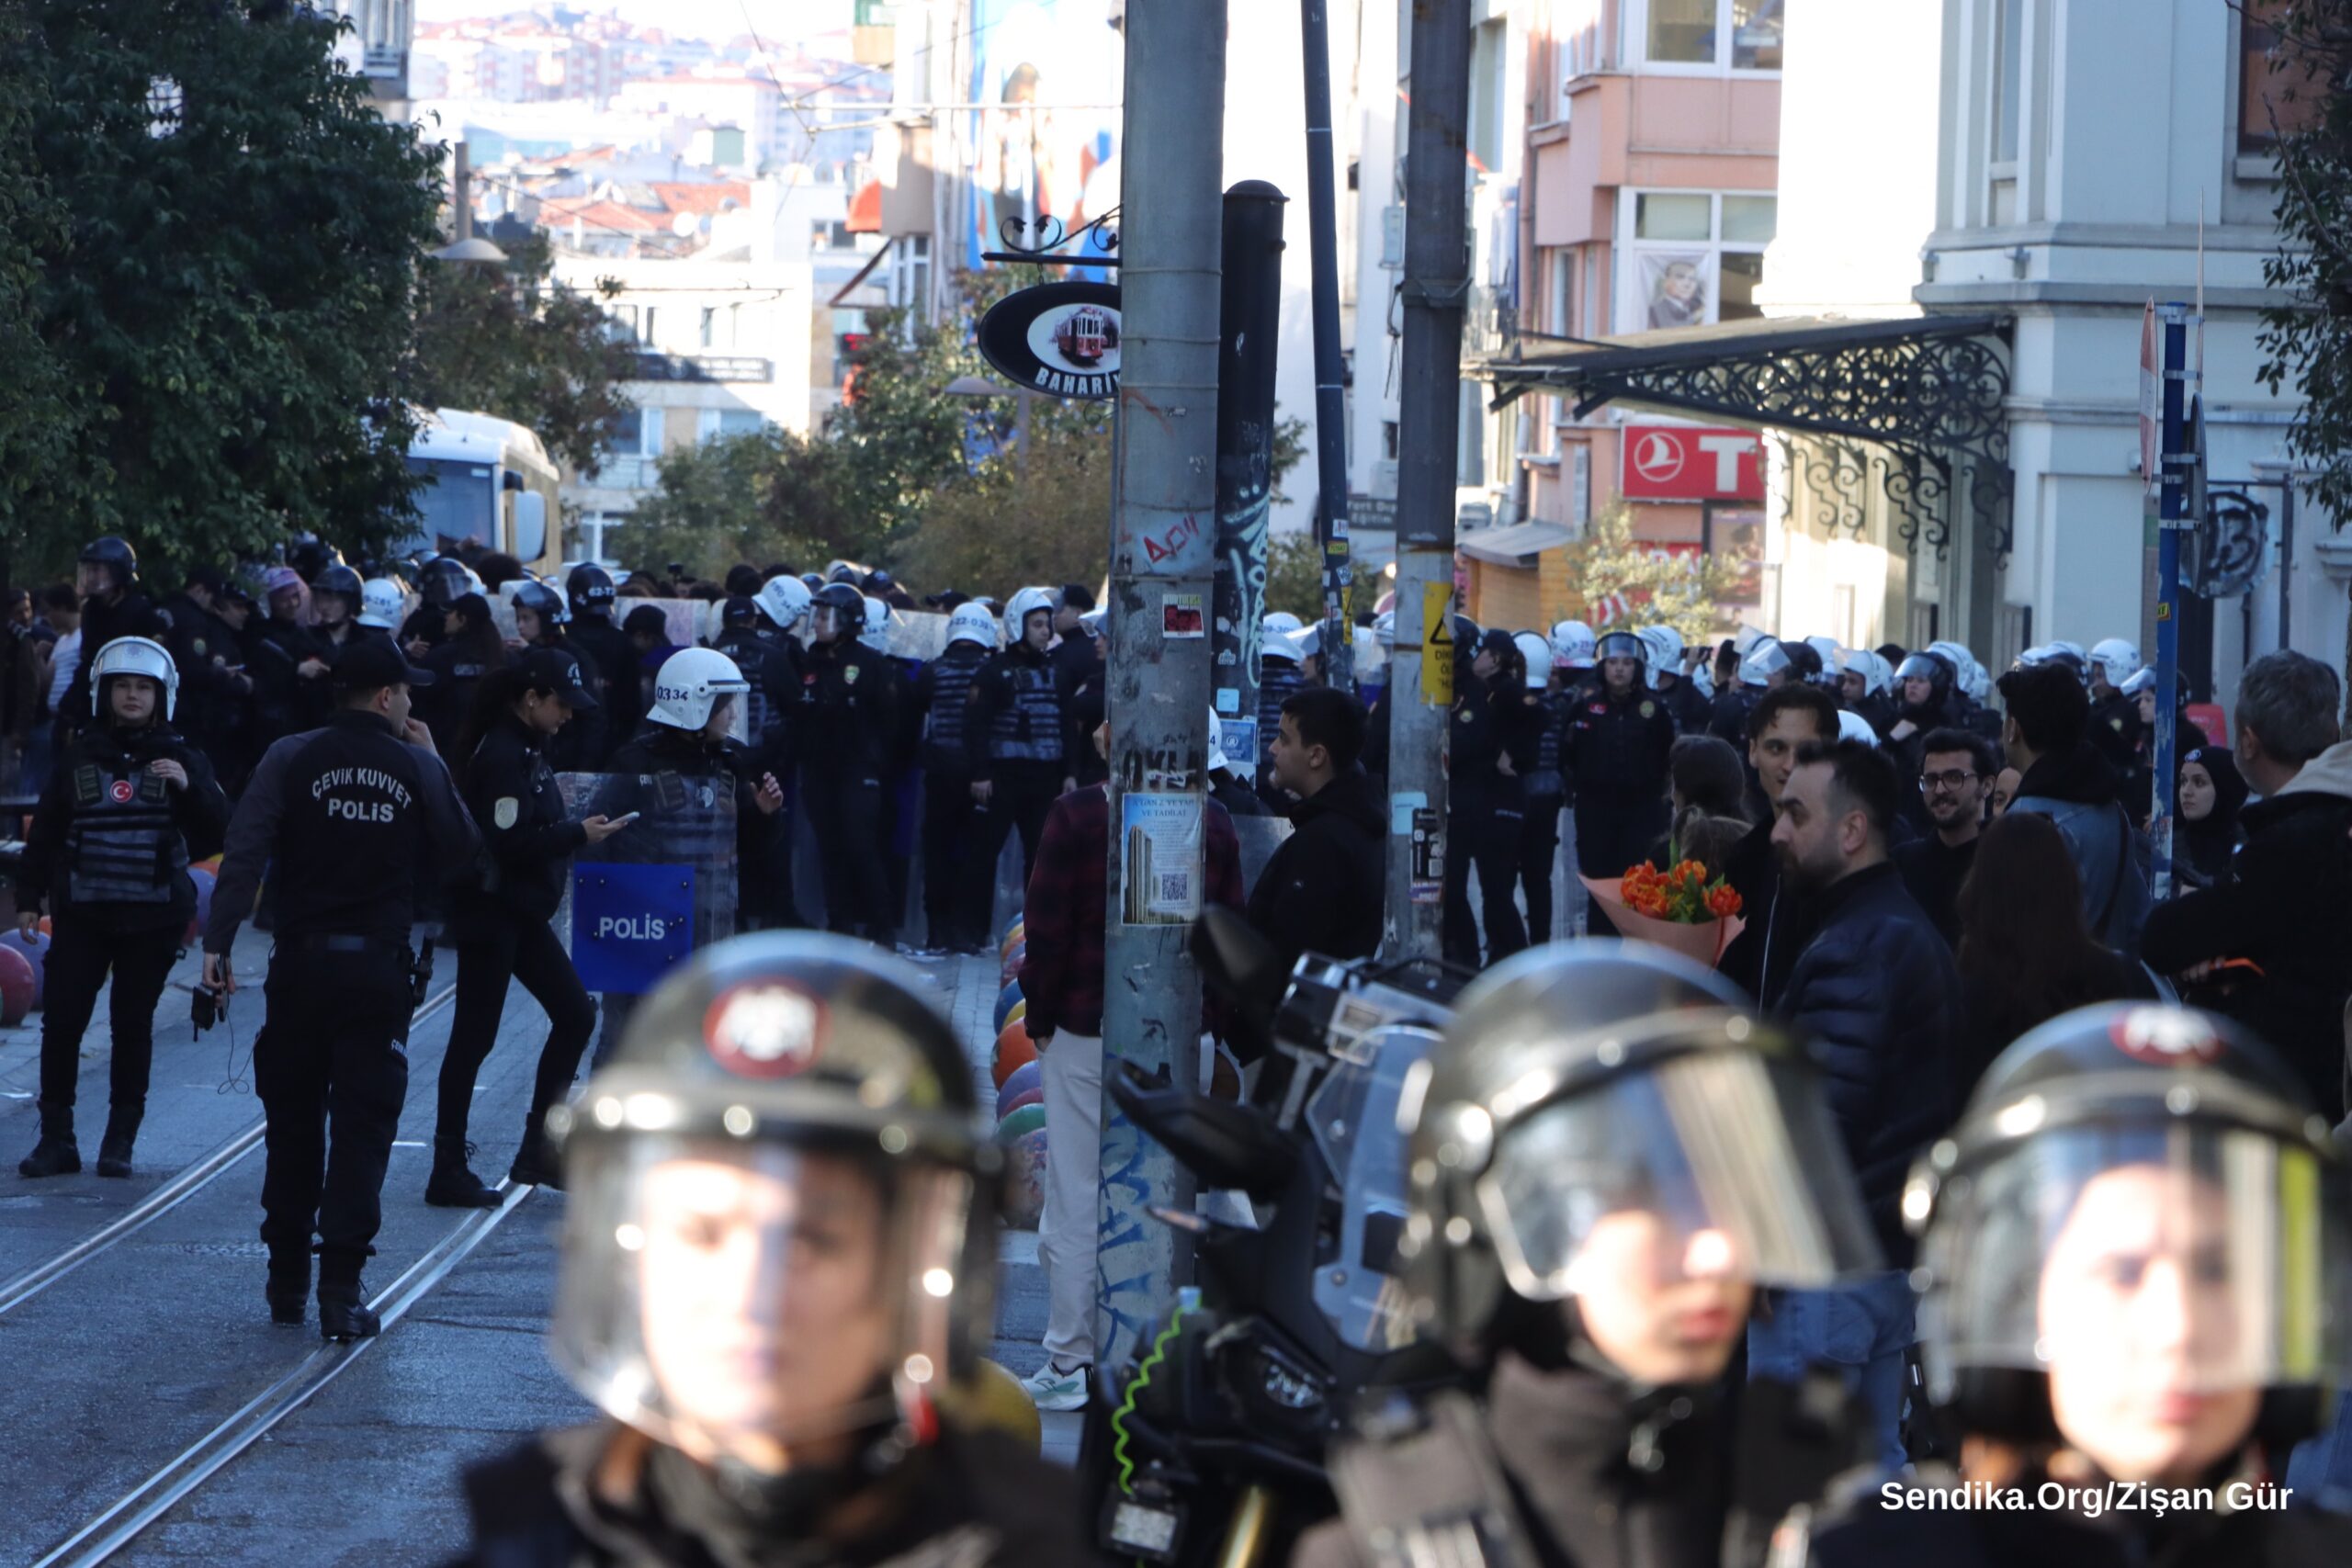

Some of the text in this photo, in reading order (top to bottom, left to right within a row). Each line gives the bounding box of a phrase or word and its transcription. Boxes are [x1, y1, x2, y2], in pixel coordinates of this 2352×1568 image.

[312, 767, 412, 809] ÇEVİK KUVVET
[328, 797, 394, 823] POLİS
[599, 912, 665, 940] POLİS
